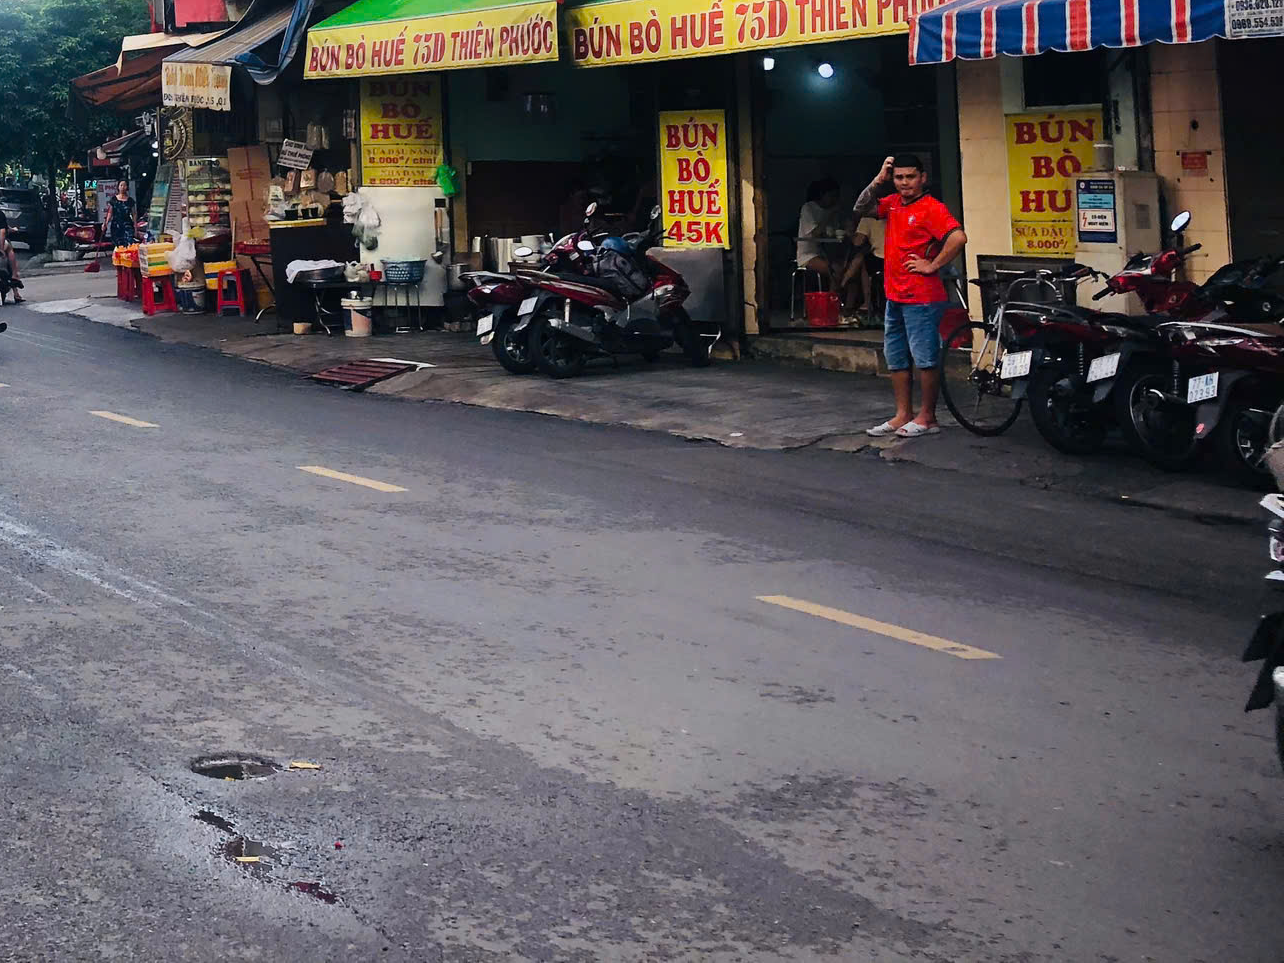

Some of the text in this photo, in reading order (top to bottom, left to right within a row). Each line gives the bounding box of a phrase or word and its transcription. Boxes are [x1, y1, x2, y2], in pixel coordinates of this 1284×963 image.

[308, 13, 554, 72] BÚN BÒ HUẾ 75D THIÊN PHƯỚC
[574, 17, 622, 60] BÚN
[629, 10, 662, 55] BÒ
[380, 99, 421, 119] BÒ
[370, 117, 434, 139] HUẾ
[665, 117, 719, 149] BÚN
[1013, 113, 1095, 145] BÚN
[677, 150, 711, 183] BÒ
[1031, 148, 1082, 179] BÒ
[667, 178, 722, 215] HUẾ
[1020, 190, 1073, 213] HU
[667, 220, 723, 244] 45K
[1015, 225, 1038, 237] SỮA
